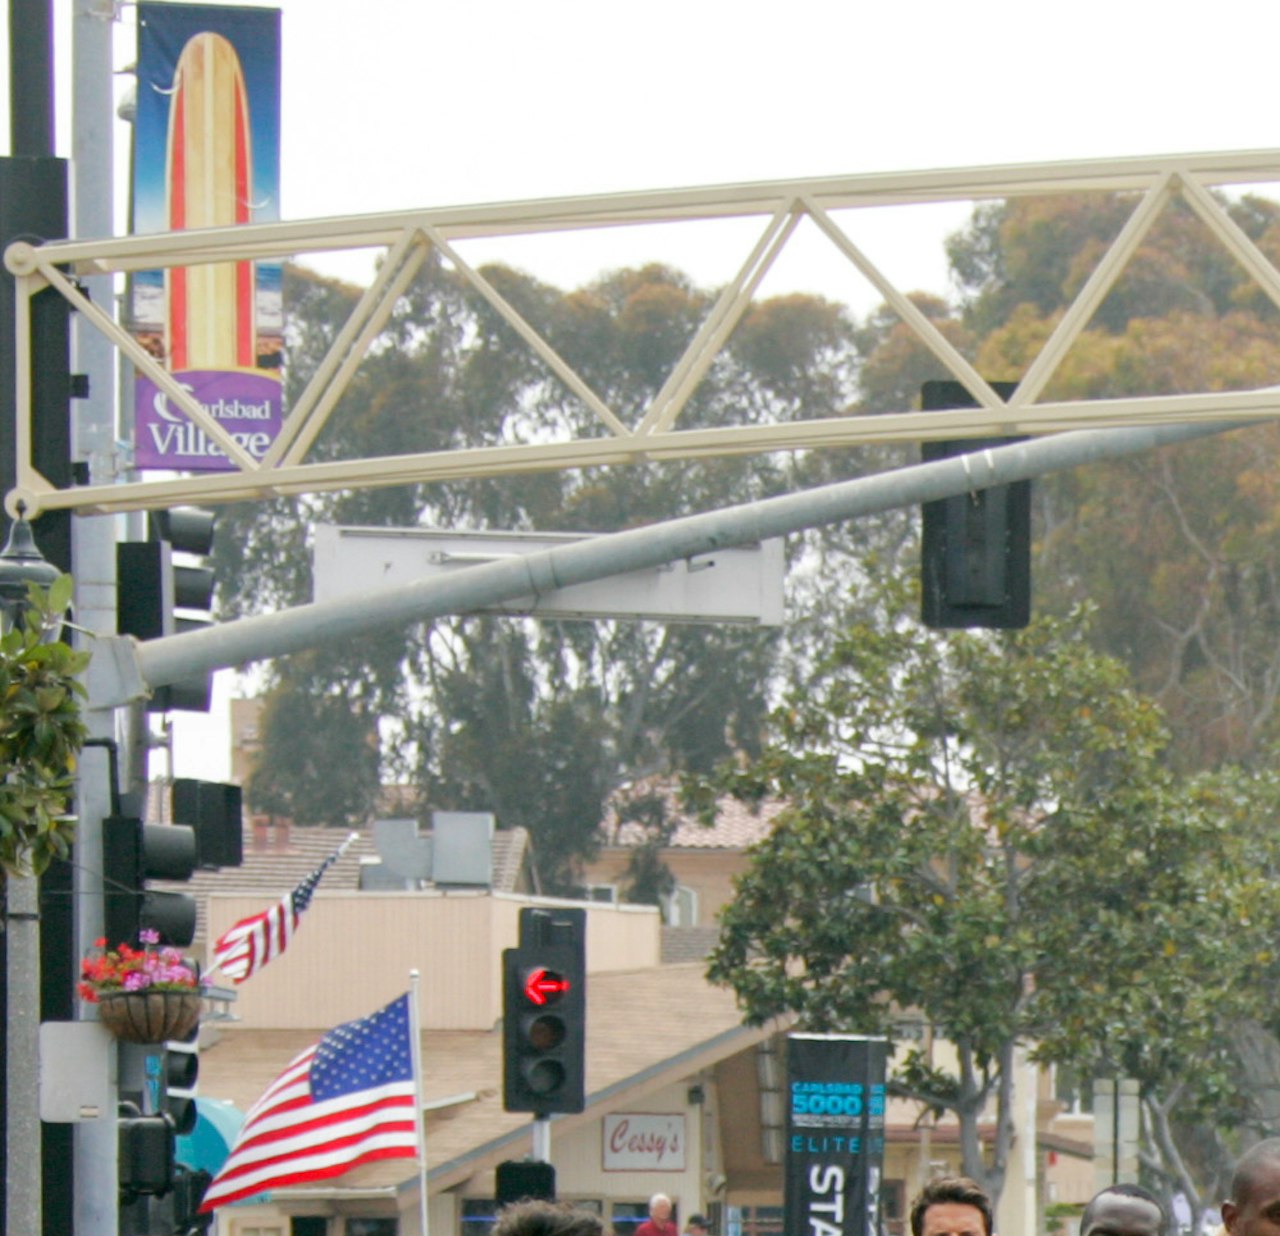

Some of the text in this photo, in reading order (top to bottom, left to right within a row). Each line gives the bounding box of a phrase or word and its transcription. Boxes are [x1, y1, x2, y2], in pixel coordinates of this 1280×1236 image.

[792, 1082, 864, 1094] CARLSBAD
[792, 1094, 863, 1116] 5000
[610, 1119, 679, 1162] Cessy's
[791, 1135, 861, 1154] ELITE
